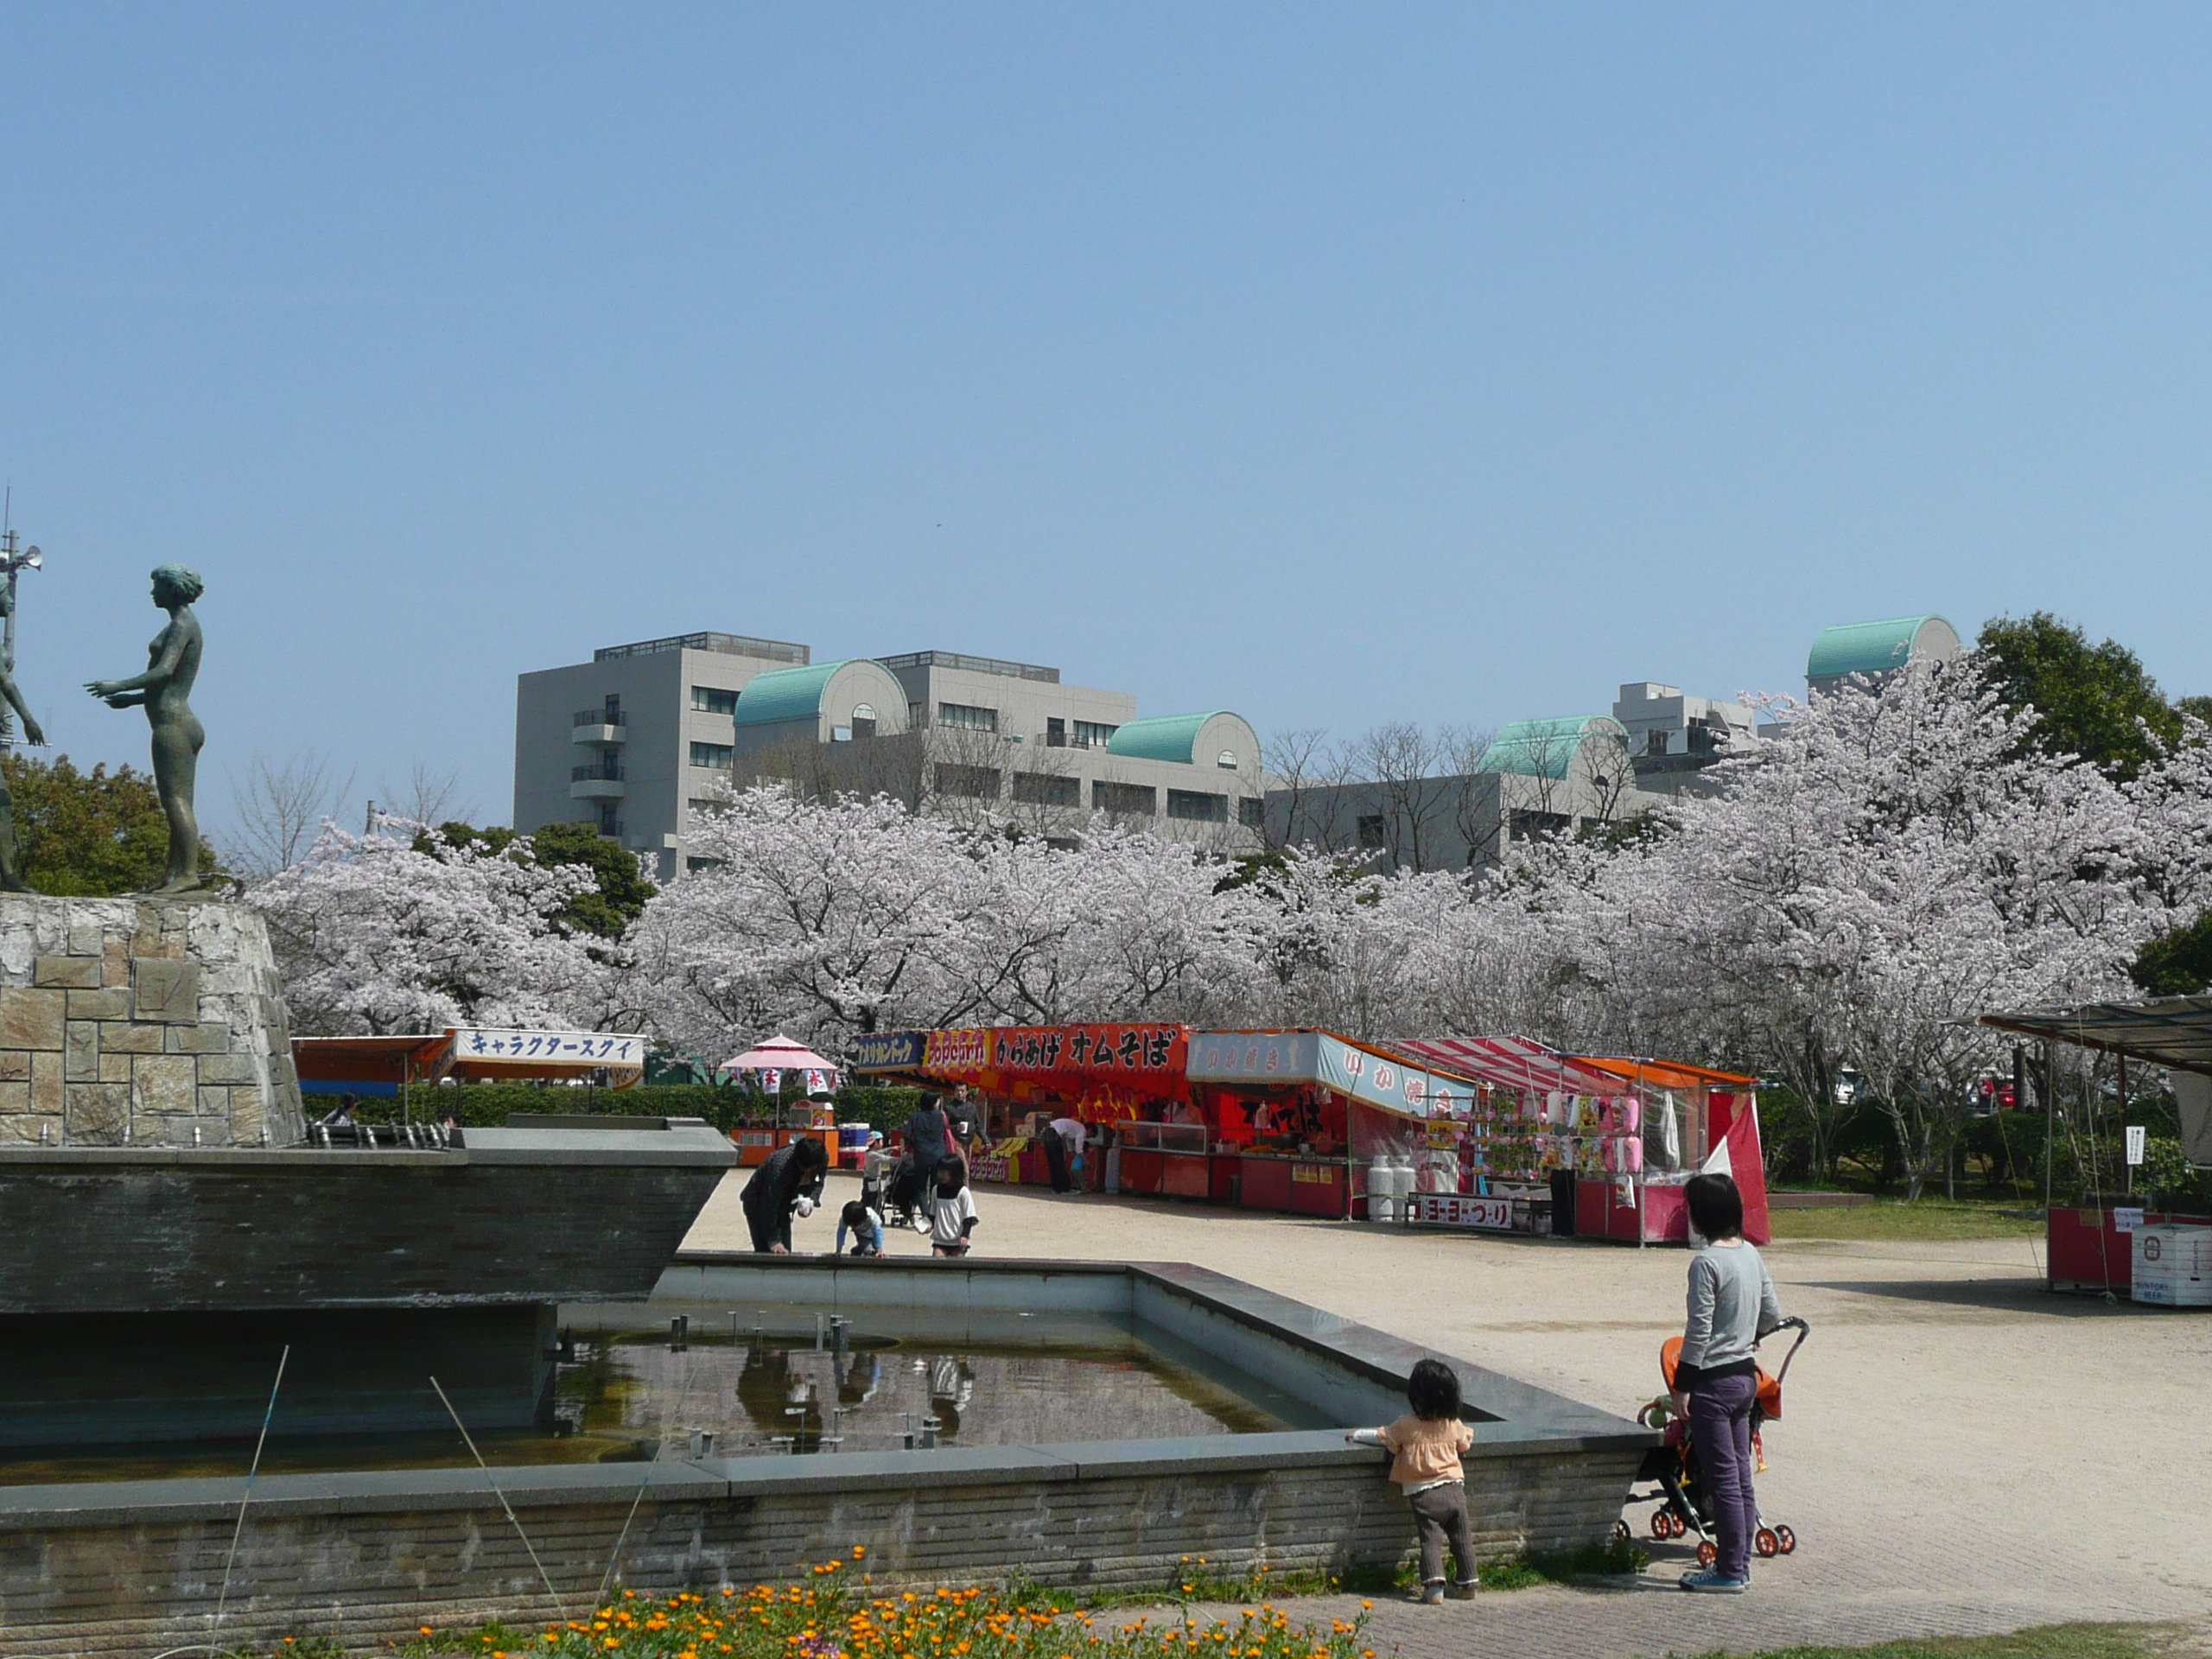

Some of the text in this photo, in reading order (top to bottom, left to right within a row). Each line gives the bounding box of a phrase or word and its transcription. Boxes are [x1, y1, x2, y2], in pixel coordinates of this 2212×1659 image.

[472, 1033, 632, 1060] キャラクタースクイ
[995, 1029, 1177, 1069] からあげ オムそば
[1207, 1046, 1279, 1072] いか焼き
[765, 1069, 779, 1085] 氷
[808, 1070, 823, 1087] 氷
[1344, 1048, 1452, 1113] いか焼き
[1427, 1199, 1508, 1225] ヨーヨーつり
